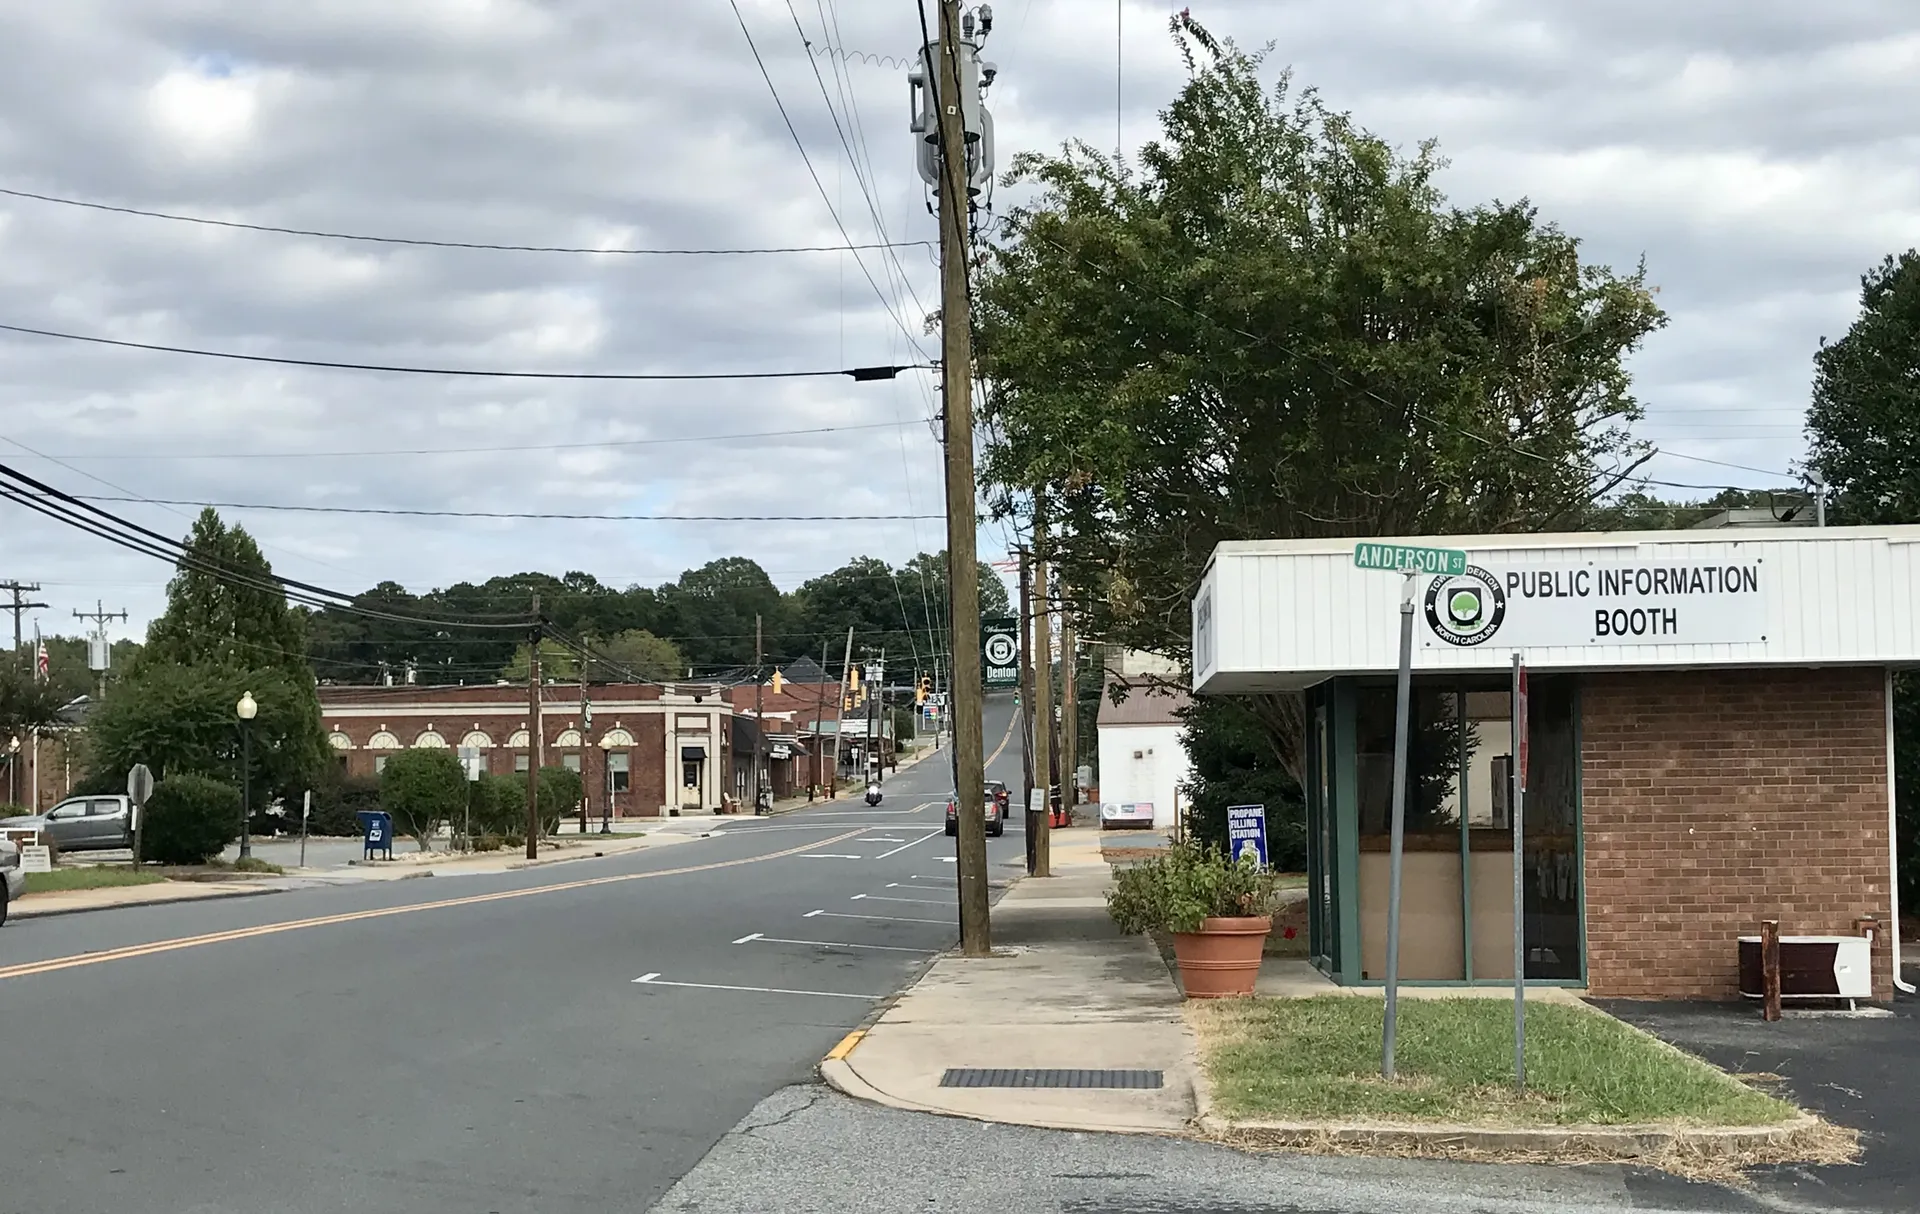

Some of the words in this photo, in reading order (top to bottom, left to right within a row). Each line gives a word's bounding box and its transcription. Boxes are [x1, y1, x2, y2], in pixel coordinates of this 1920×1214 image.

[1357, 545, 1449, 572] ANDERSON
[1452, 558, 1463, 569] ST
[1430, 574, 1449, 592] TOW
[1467, 566, 1500, 591] DENTON
[1506, 570, 1590, 598] PUBLIC
[1598, 565, 1758, 597] INFORMATION
[1595, 608, 1677, 636] BOOTH
[1434, 624, 1460, 644] NORTH
[1460, 623, 1498, 645] CAROLINA
[986, 665, 1017, 679] Denton
[1229, 807, 1263, 819] PROPANE
[1230, 818, 1258, 829] FILLING
[1231, 828, 1261, 839] STATION
